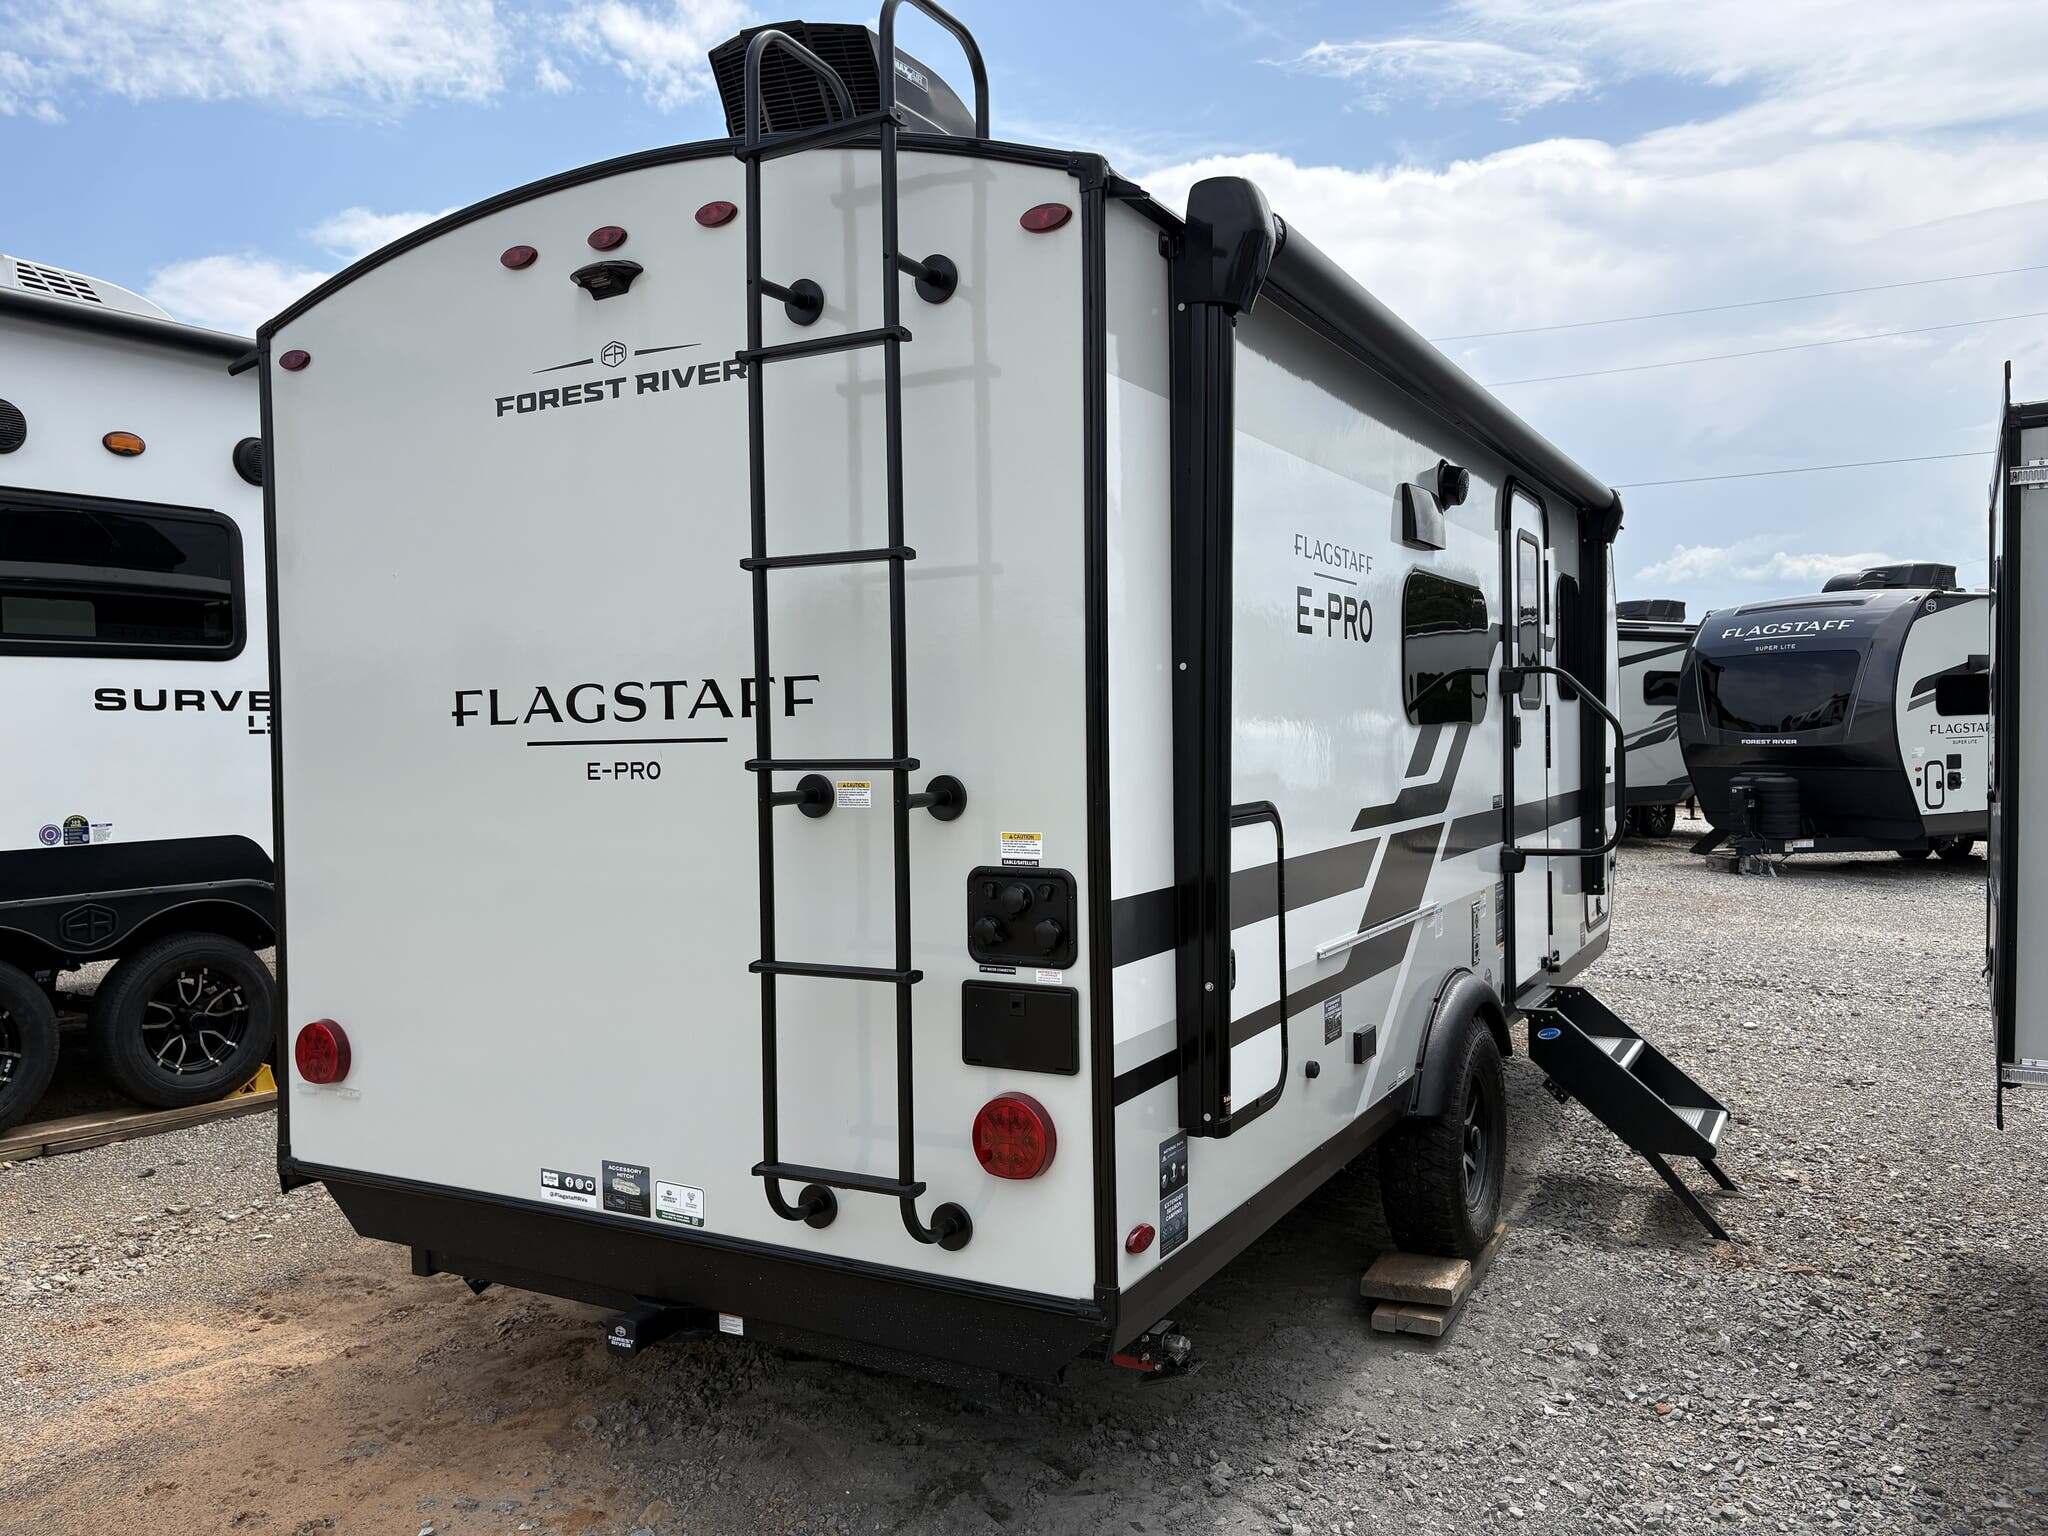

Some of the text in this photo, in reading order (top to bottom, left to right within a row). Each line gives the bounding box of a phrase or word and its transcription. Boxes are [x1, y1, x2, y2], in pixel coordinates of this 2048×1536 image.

[494, 358, 749, 418] FOREST RIVER
[1294, 533, 1373, 575] FLAGSTAFF
[1296, 585, 1373, 643] E-PRO
[1721, 619, 1855, 639] FLAGSTAFF
[451, 674, 821, 728] FLAGSTAFF
[587, 760, 662, 781] E-PRO
[608, 1165, 643, 1175] ACCESSORY
[608, 1335, 634, 1345] FOREST
[611, 1340, 632, 1348] RIVER
